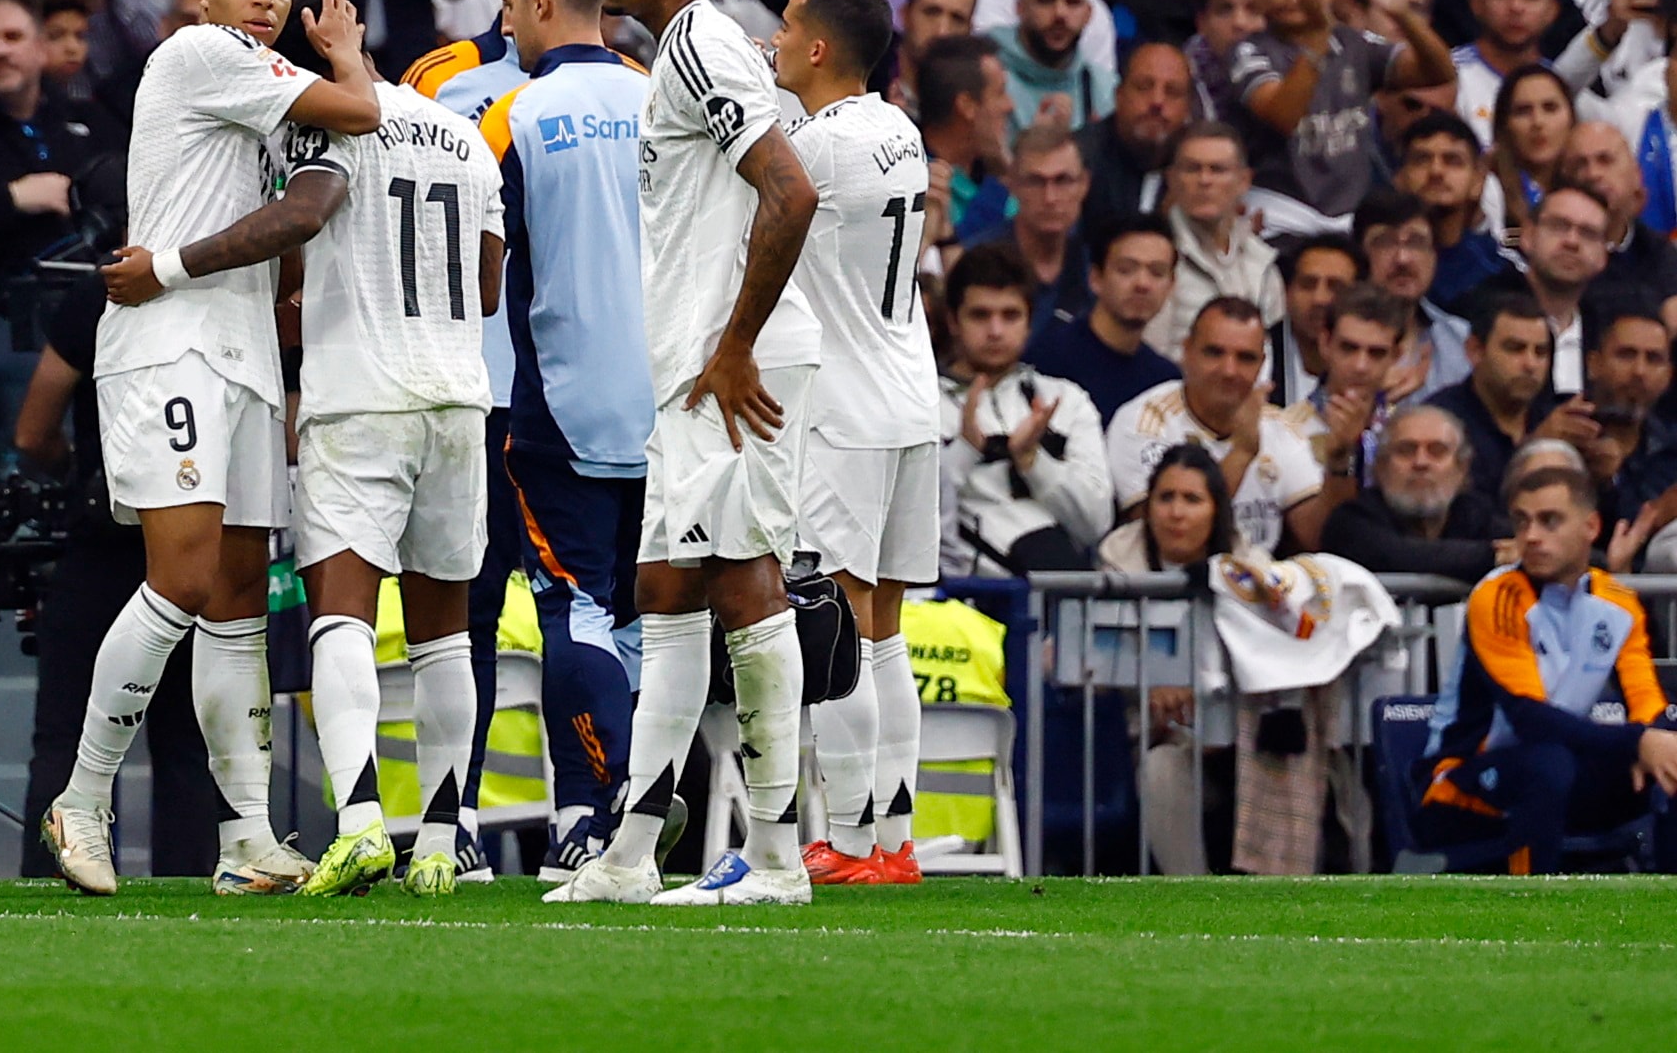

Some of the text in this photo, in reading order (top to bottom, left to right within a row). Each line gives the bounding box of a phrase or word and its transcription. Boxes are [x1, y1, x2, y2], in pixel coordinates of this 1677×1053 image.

[377, 116, 470, 162] RODRYGO
[388, 177, 466, 321] 11
[164, 396, 197, 453] 9
